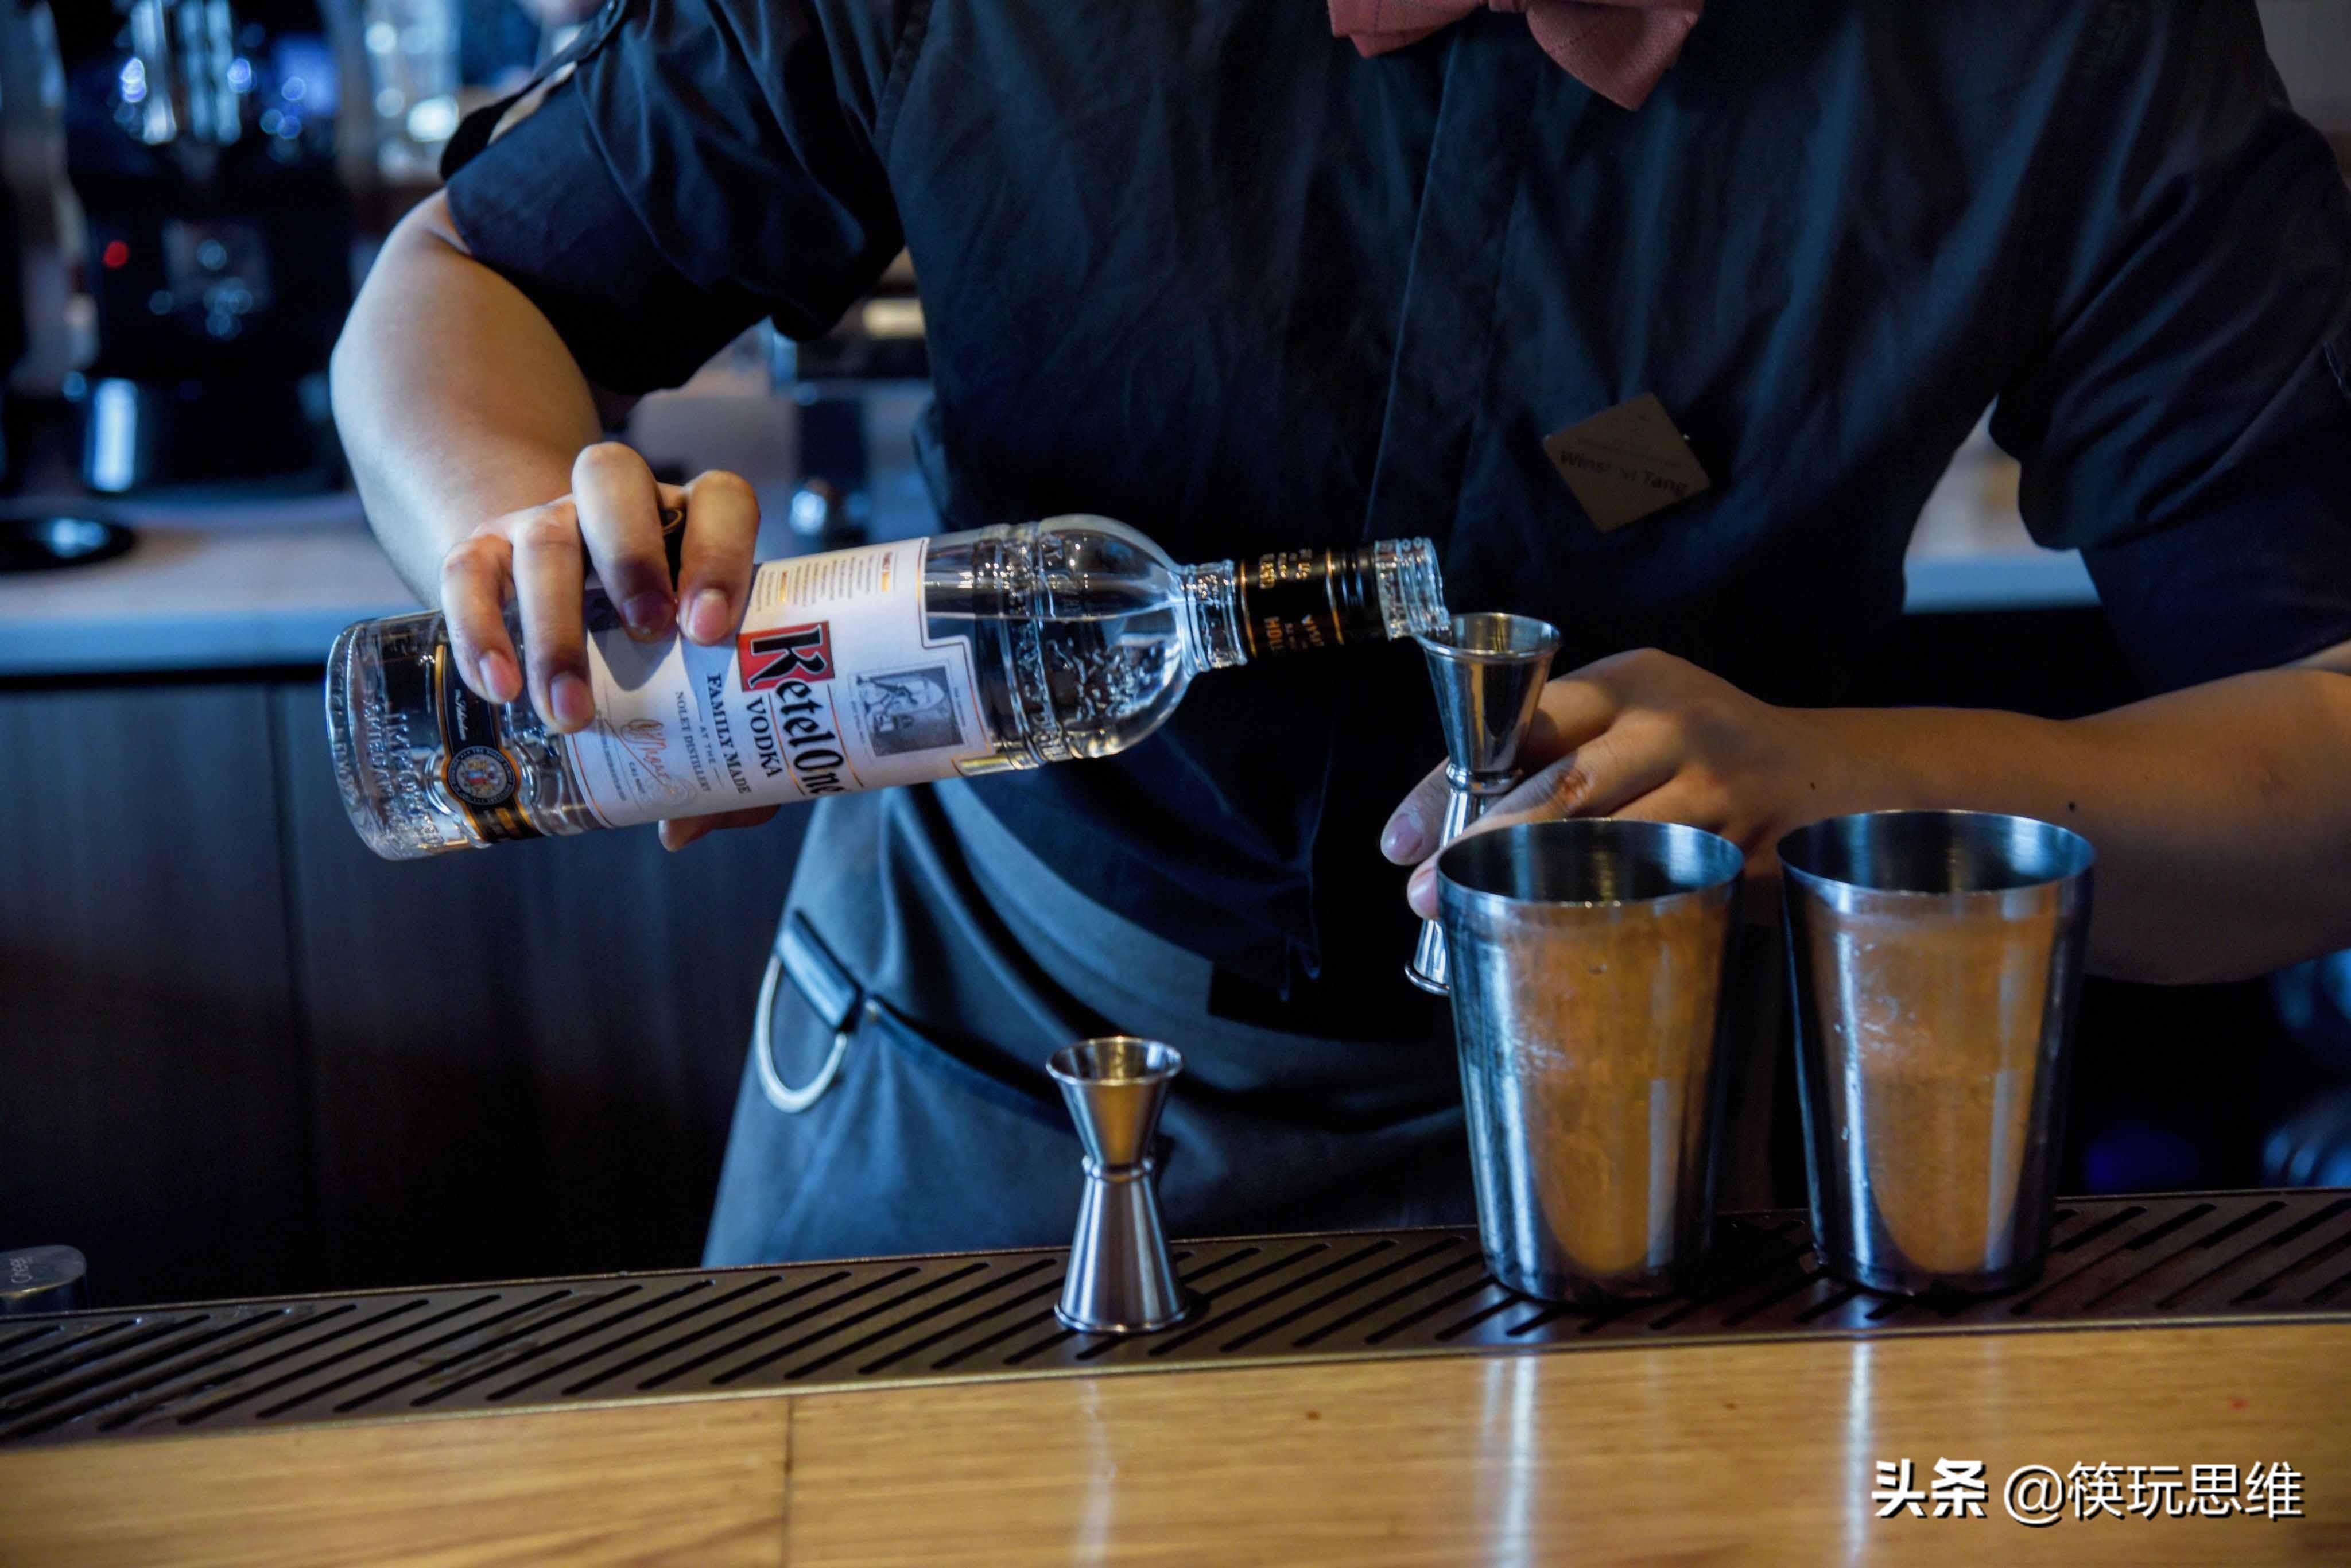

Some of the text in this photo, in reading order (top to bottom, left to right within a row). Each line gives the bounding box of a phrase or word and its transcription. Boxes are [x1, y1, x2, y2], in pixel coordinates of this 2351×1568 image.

[707, 672, 752, 795] FAMILY MADE
[748, 622, 836, 748] Ketel
[675, 690, 712, 793] NOLET DISTILLERY
[699, 725, 717, 764] AT THE
[746, 697, 783, 778] VODKA
